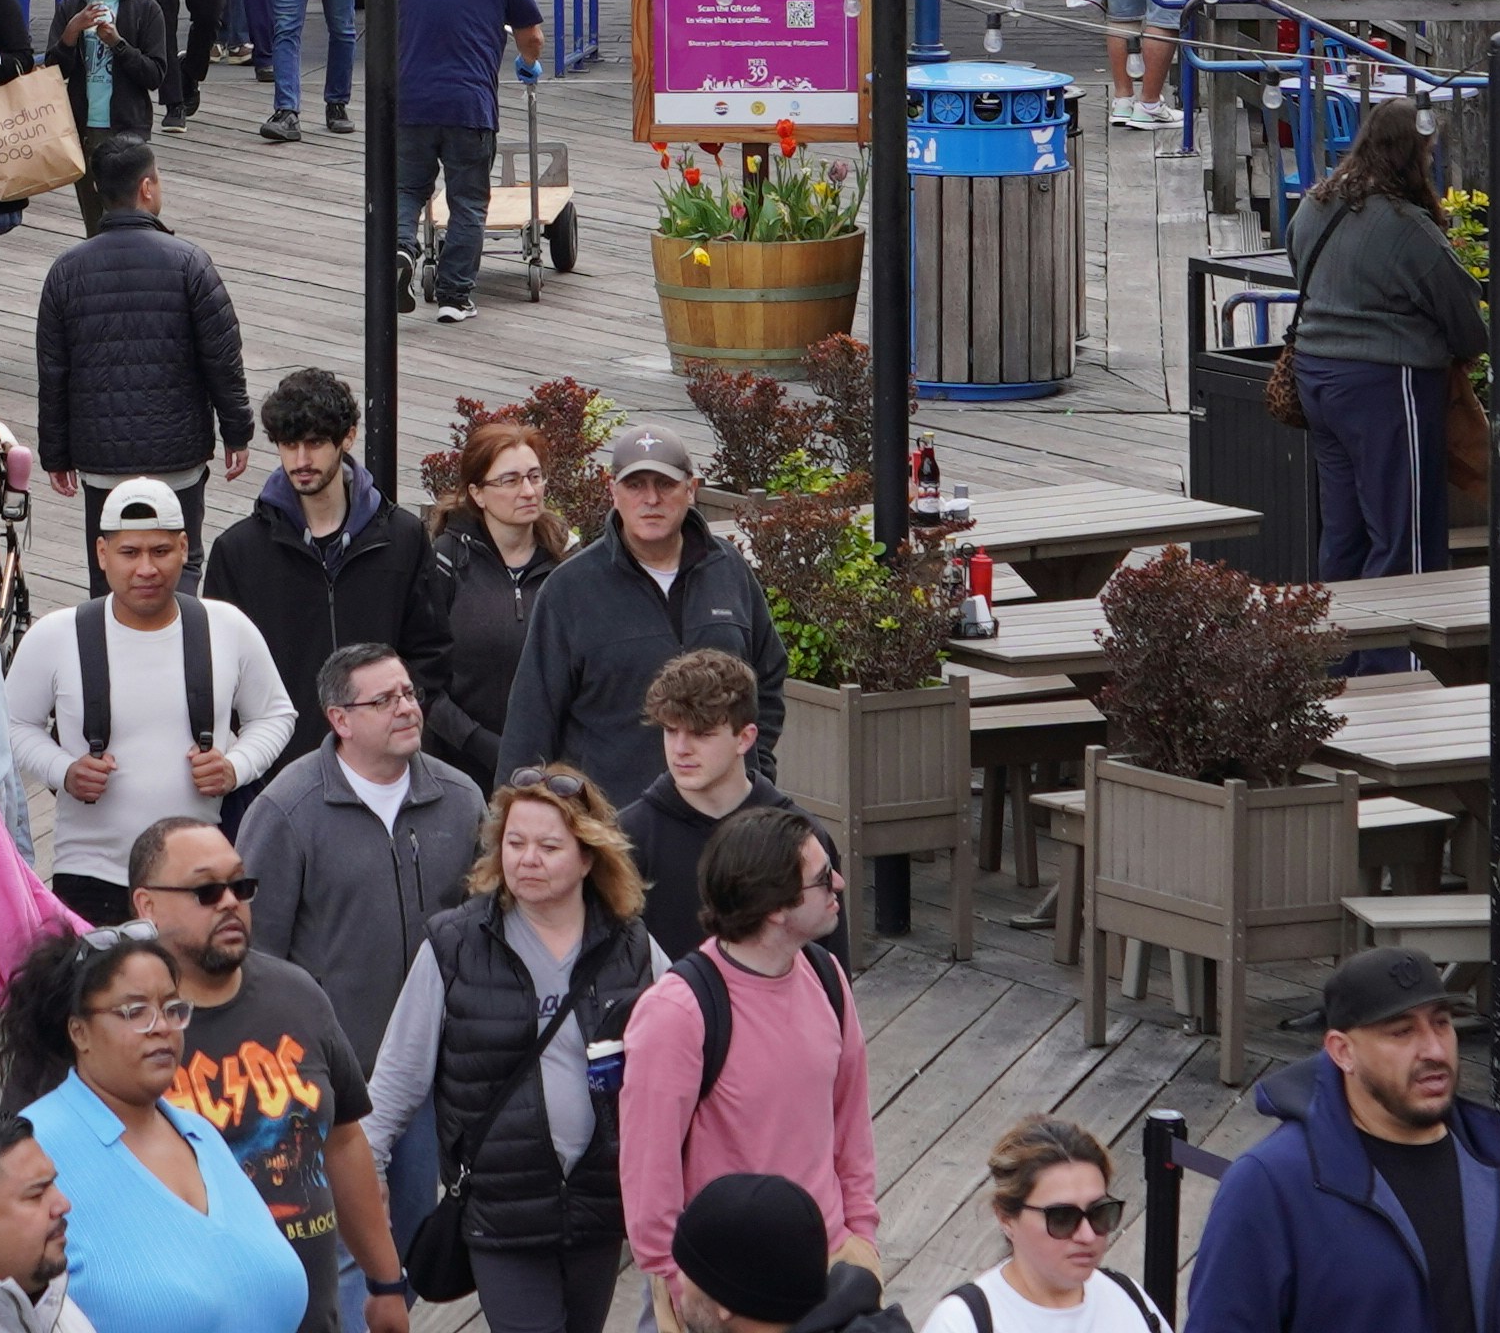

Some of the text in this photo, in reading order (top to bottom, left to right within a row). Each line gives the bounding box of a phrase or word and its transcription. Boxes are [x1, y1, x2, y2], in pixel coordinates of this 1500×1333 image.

[697, 5, 715, 13] Scan
[730, 5, 742, 13] QR
[742, 5, 761, 13] code
[714, 16, 727, 24] the
[747, 58, 767, 66] PIER
[747, 66, 769, 83] 39
[285, 1222, 304, 1240] BE
